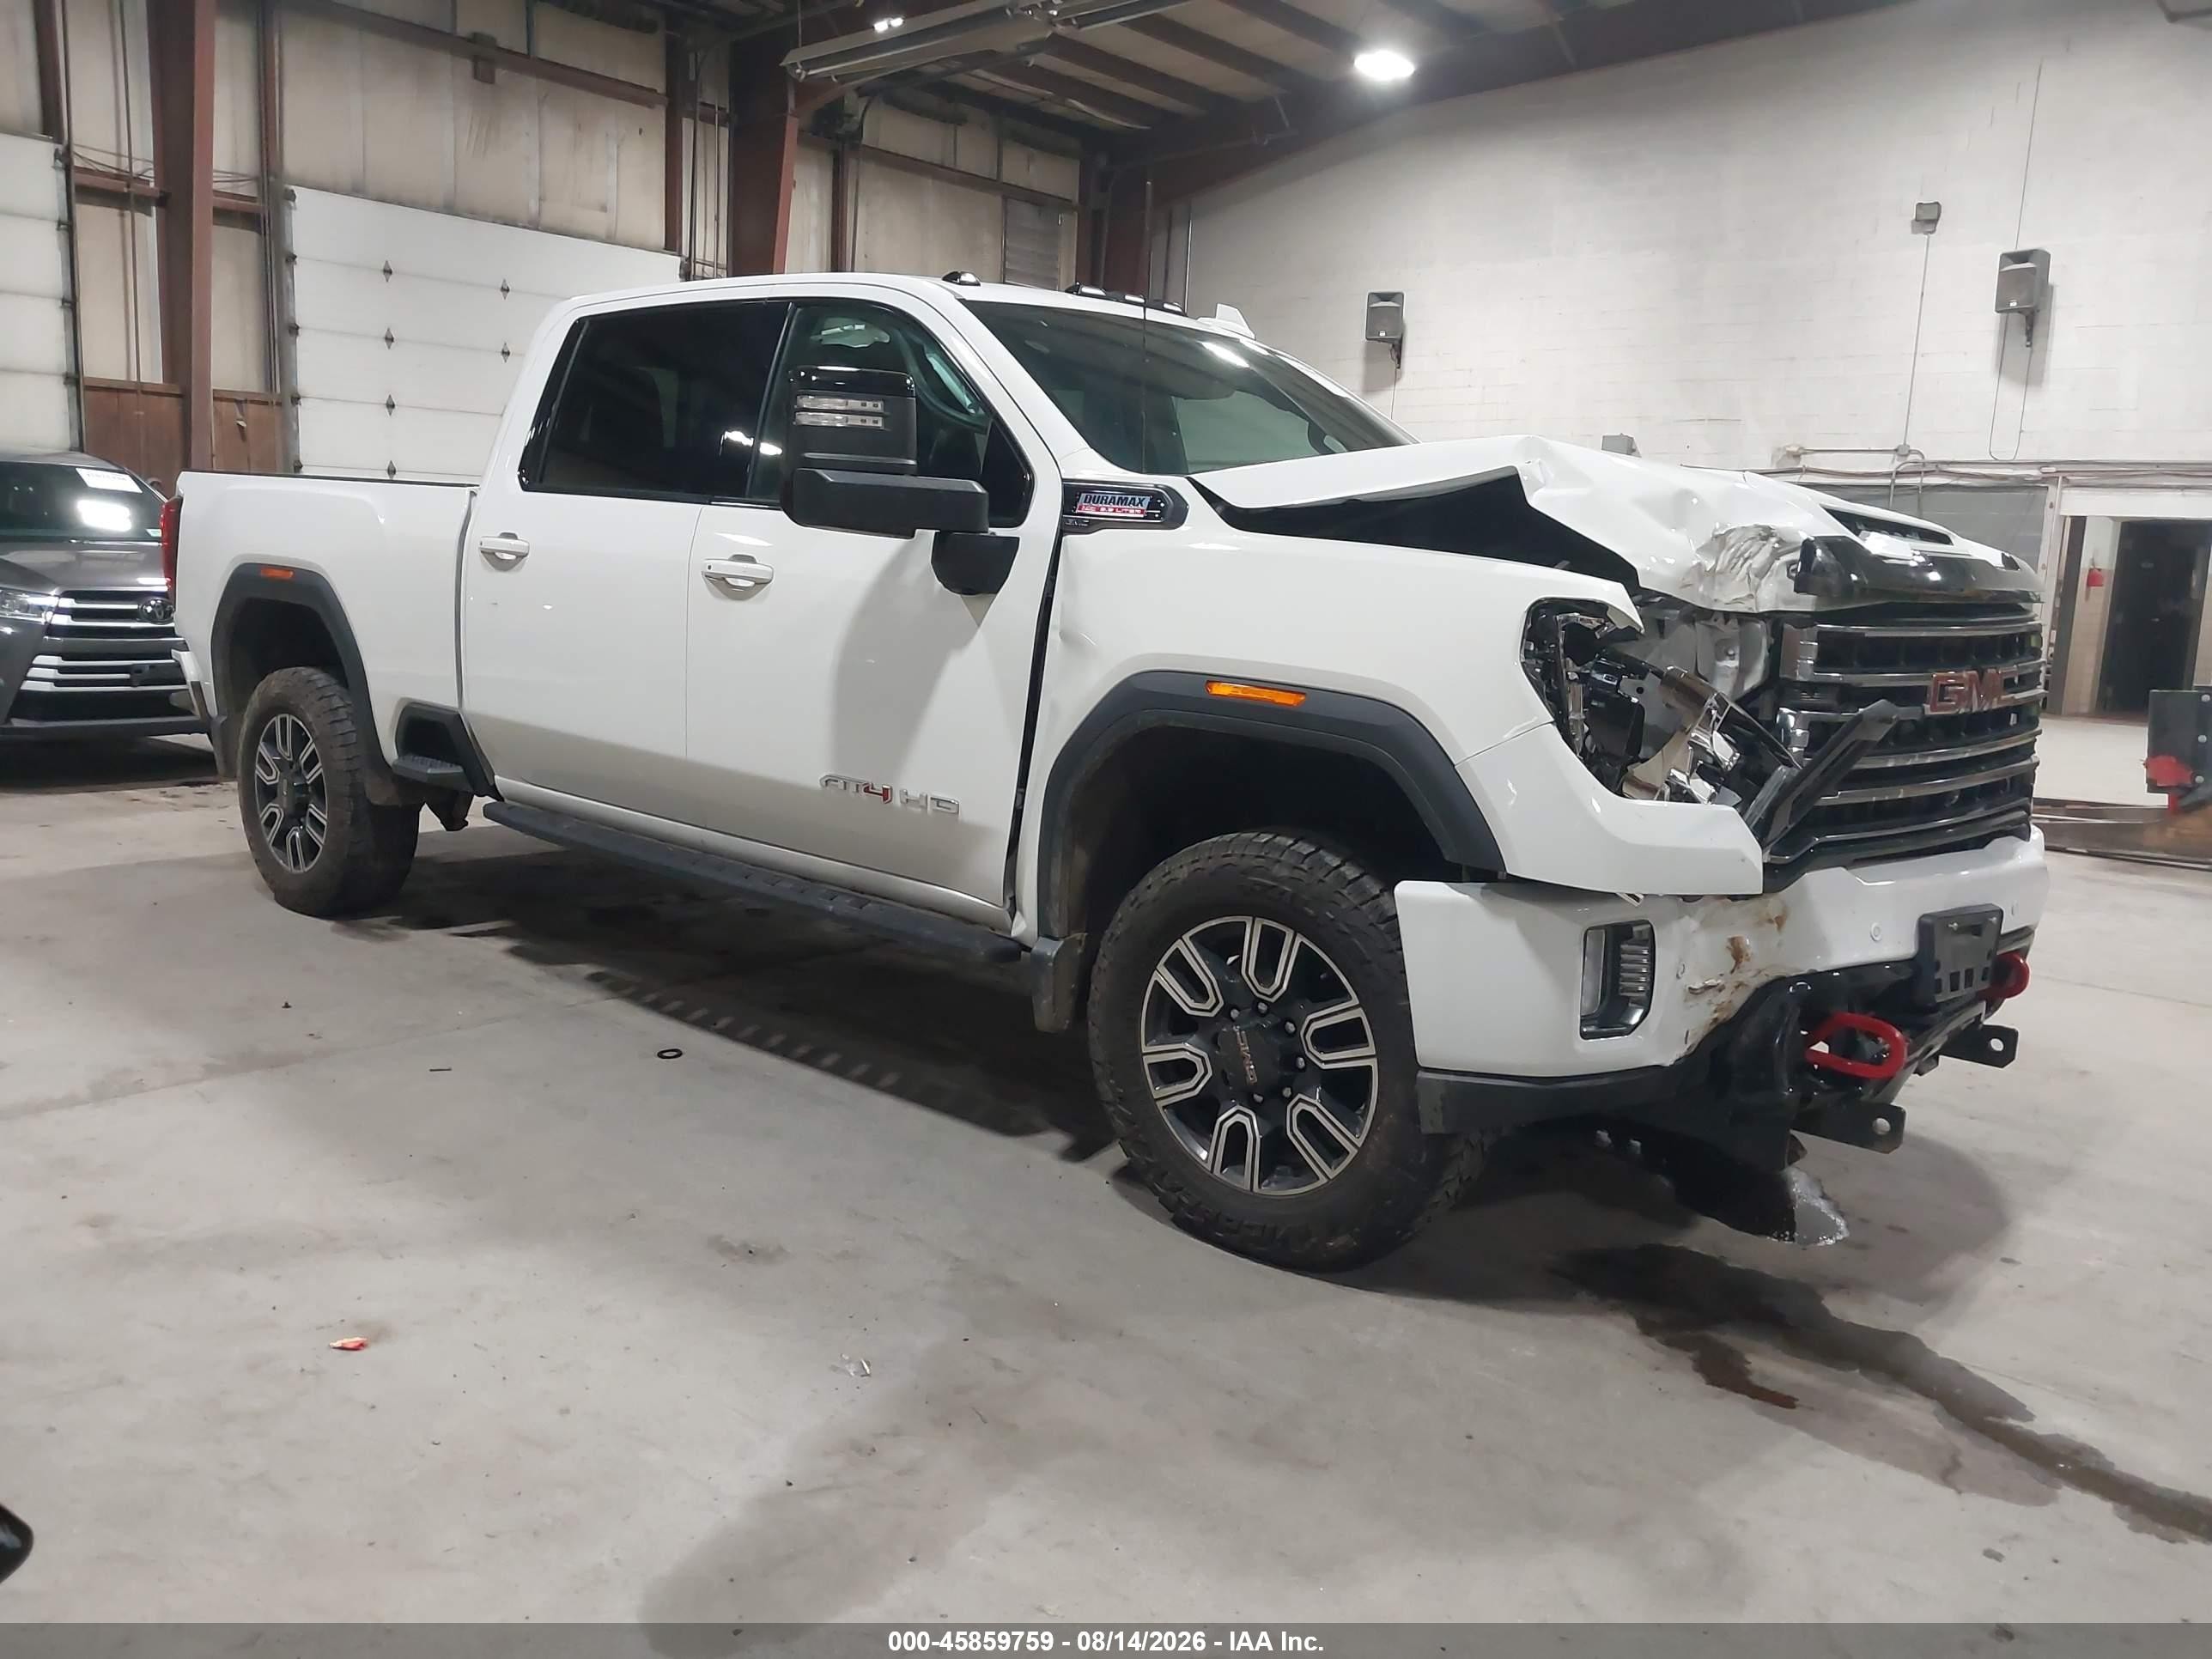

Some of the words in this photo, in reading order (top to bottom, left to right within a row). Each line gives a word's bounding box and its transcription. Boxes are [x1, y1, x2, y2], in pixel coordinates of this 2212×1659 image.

[1084, 495, 1146, 507] DURAMAX
[1924, 665, 2019, 714] GMC
[819, 774, 893, 805] AT4
[899, 788, 960, 814] HD
